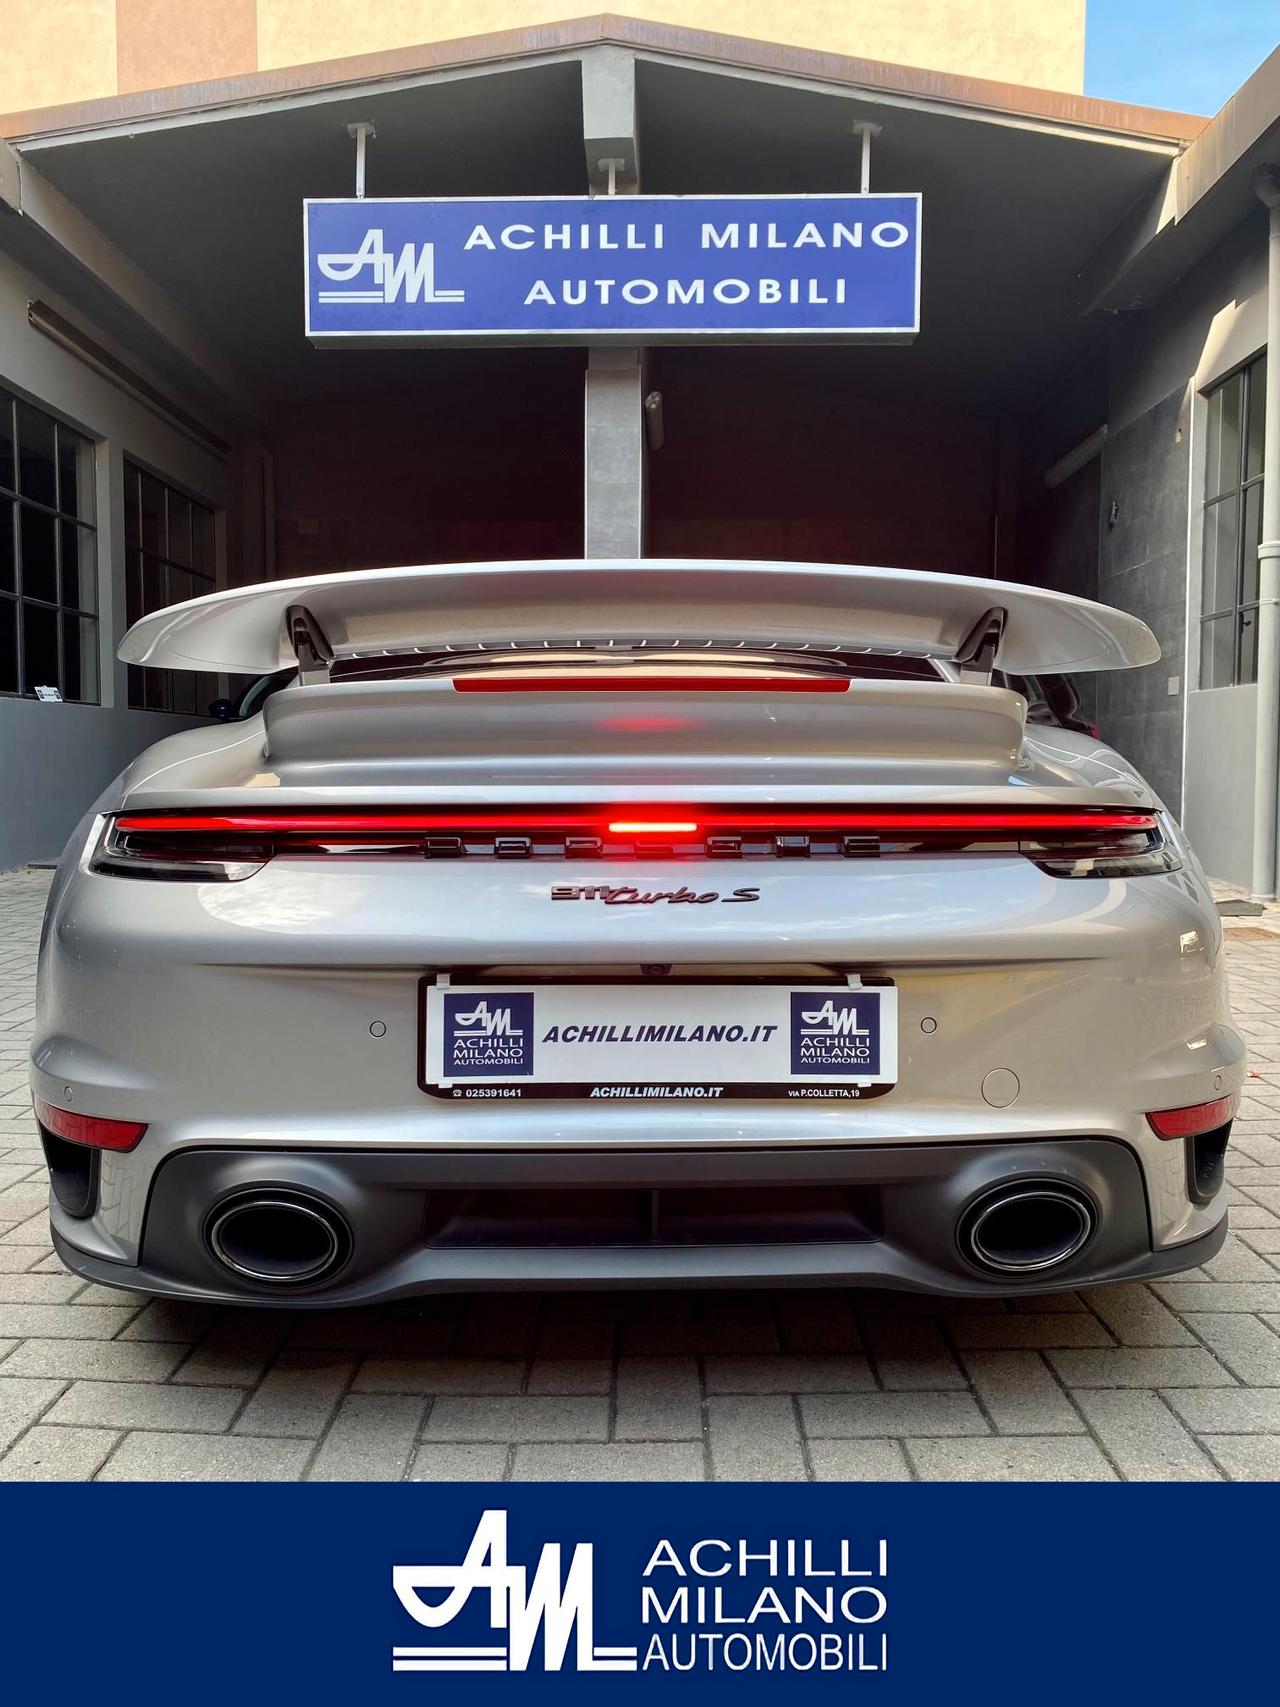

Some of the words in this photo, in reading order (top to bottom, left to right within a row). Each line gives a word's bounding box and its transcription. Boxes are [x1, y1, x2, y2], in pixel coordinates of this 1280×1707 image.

[463, 223, 664, 251] ACHILLI
[701, 221, 909, 249] MILANO
[523, 277, 847, 305] AUTOMOBILI
[721, 887, 761, 903] S
[542, 1025, 777, 1043] ACHILLIMILANO.IT
[453, 1038, 524, 1048] ACHILLI
[800, 1037, 870, 1047] ACHILLI
[453, 1048, 524, 1058] MILANO
[800, 1047, 870, 1057] MILANO
[466, 1089, 522, 1098] 025391641
[590, 1086, 724, 1098] ACHILLIMILANO.IT
[801, 1089, 860, 1098] P.COLLETTA,19
